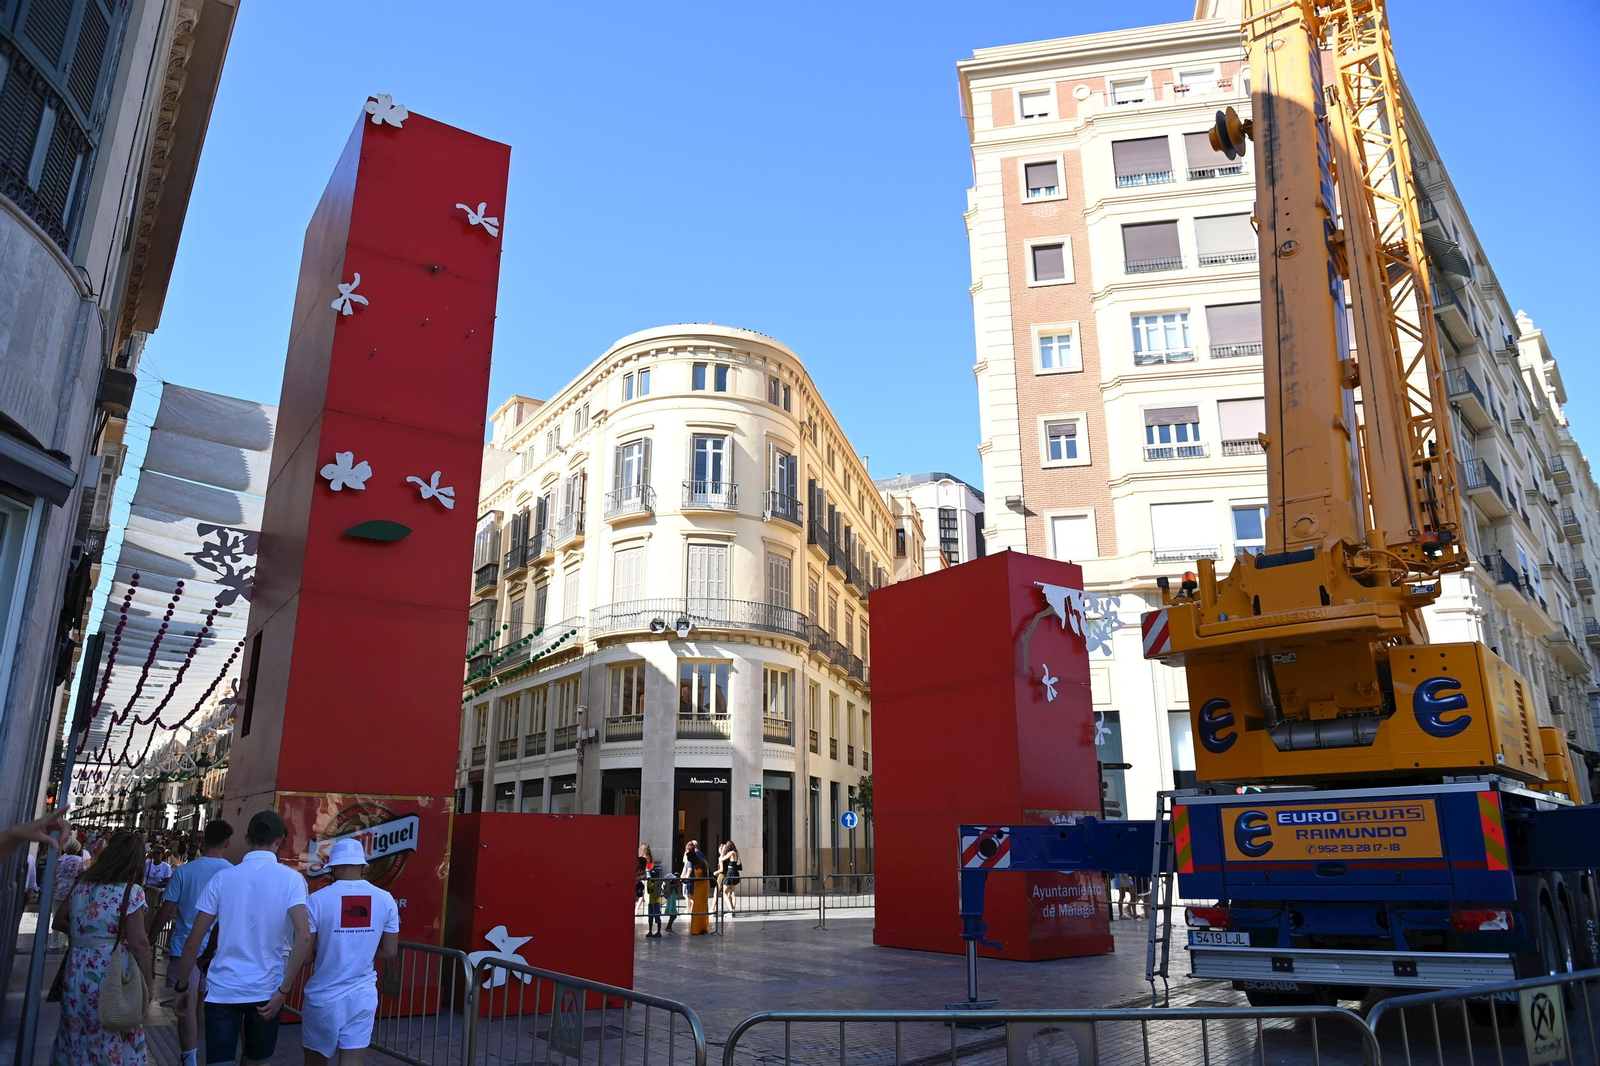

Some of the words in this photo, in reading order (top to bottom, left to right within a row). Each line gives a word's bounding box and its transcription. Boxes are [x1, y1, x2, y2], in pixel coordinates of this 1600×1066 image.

[1242, 609, 1324, 629] LIEBHERR
[352, 822, 414, 856] Miguel
[1295, 826, 1408, 840] RAIMUNDO
[1318, 845, 1339, 853] 952
[1340, 844, 1354, 853] 23
[1356, 844, 1371, 853] 28
[1032, 883, 1102, 901] Ayuntamiento
[1042, 904, 1056, 918] de
[1058, 902, 1095, 918] Málaga
[1196, 932, 1222, 944] 5419
[1225, 933, 1245, 944] LJL
[1243, 980, 1299, 991] SCANIA
